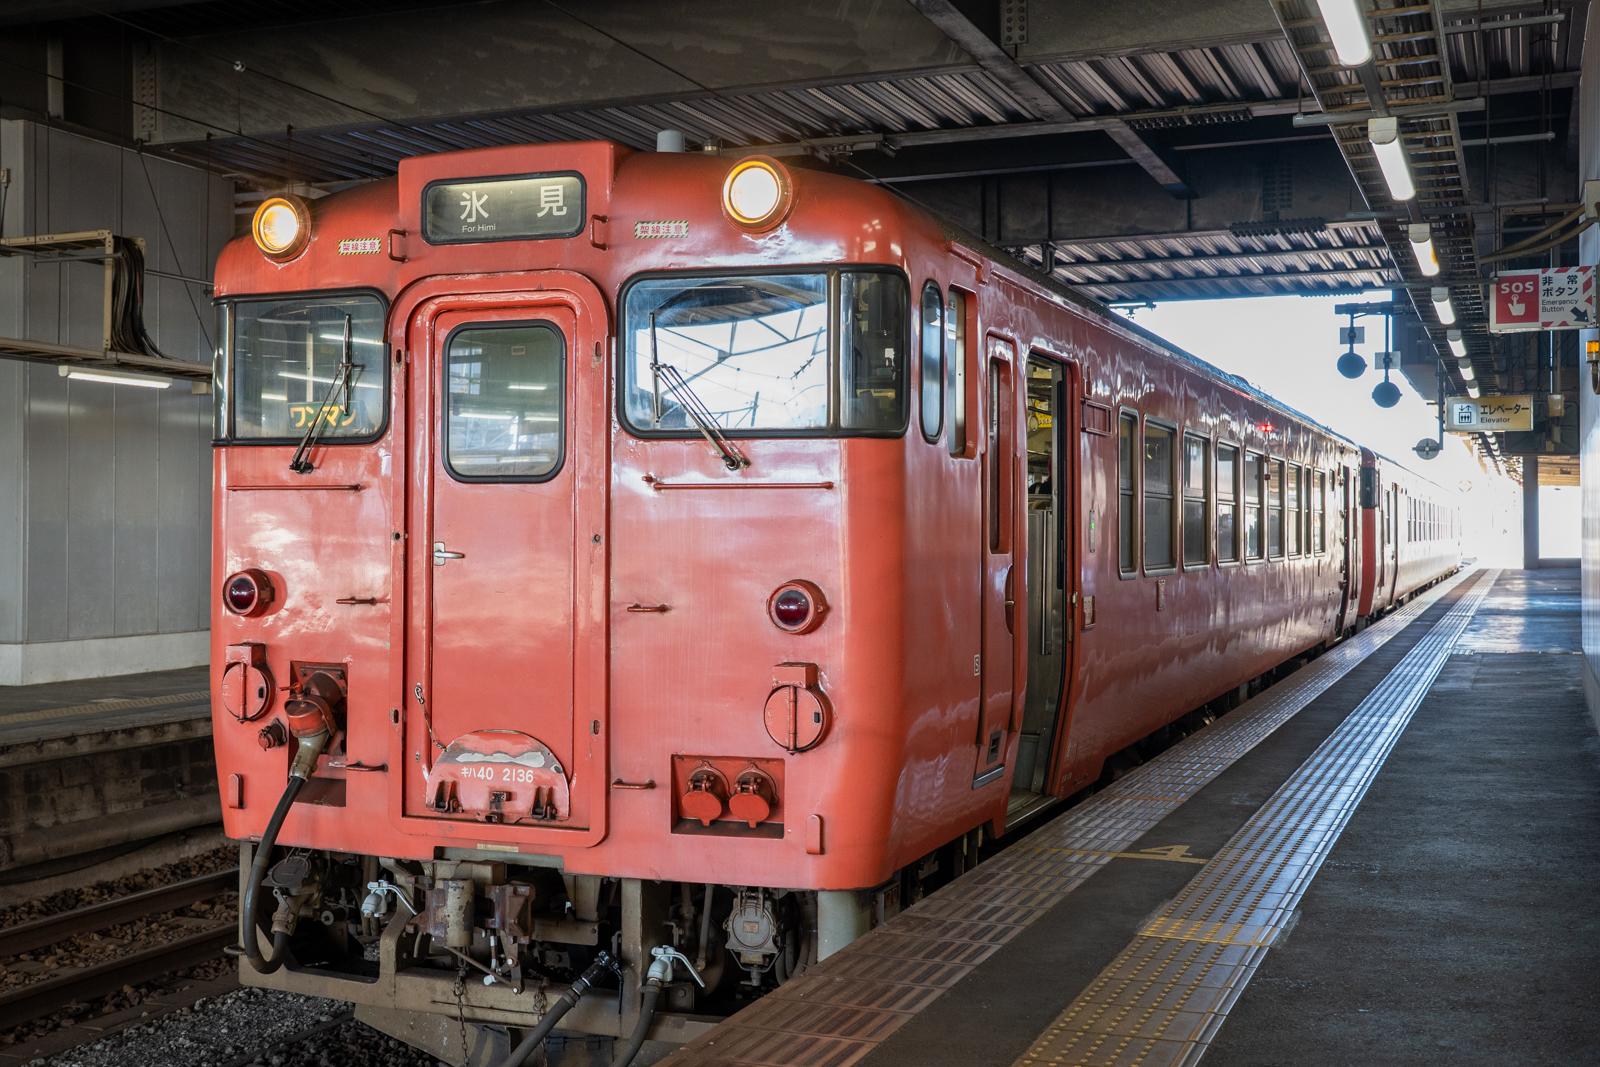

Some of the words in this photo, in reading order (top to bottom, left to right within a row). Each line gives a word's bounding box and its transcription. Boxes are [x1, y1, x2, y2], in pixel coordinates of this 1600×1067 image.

[460, 184, 567, 223] 氷見
[462, 225, 476, 233] For
[478, 223, 496, 231] Himi
[1542, 274, 1578, 286] 非常
[1500, 281, 1534, 294] SOS
[1542, 287, 1578, 297] ボタン
[1542, 298, 1578, 306] Emergency
[1480, 404, 1529, 415] エレベーター
[290, 405, 357, 428] ワンマン
[461, 766, 494, 780] キハ40
[502, 768, 534, 783] 2136
